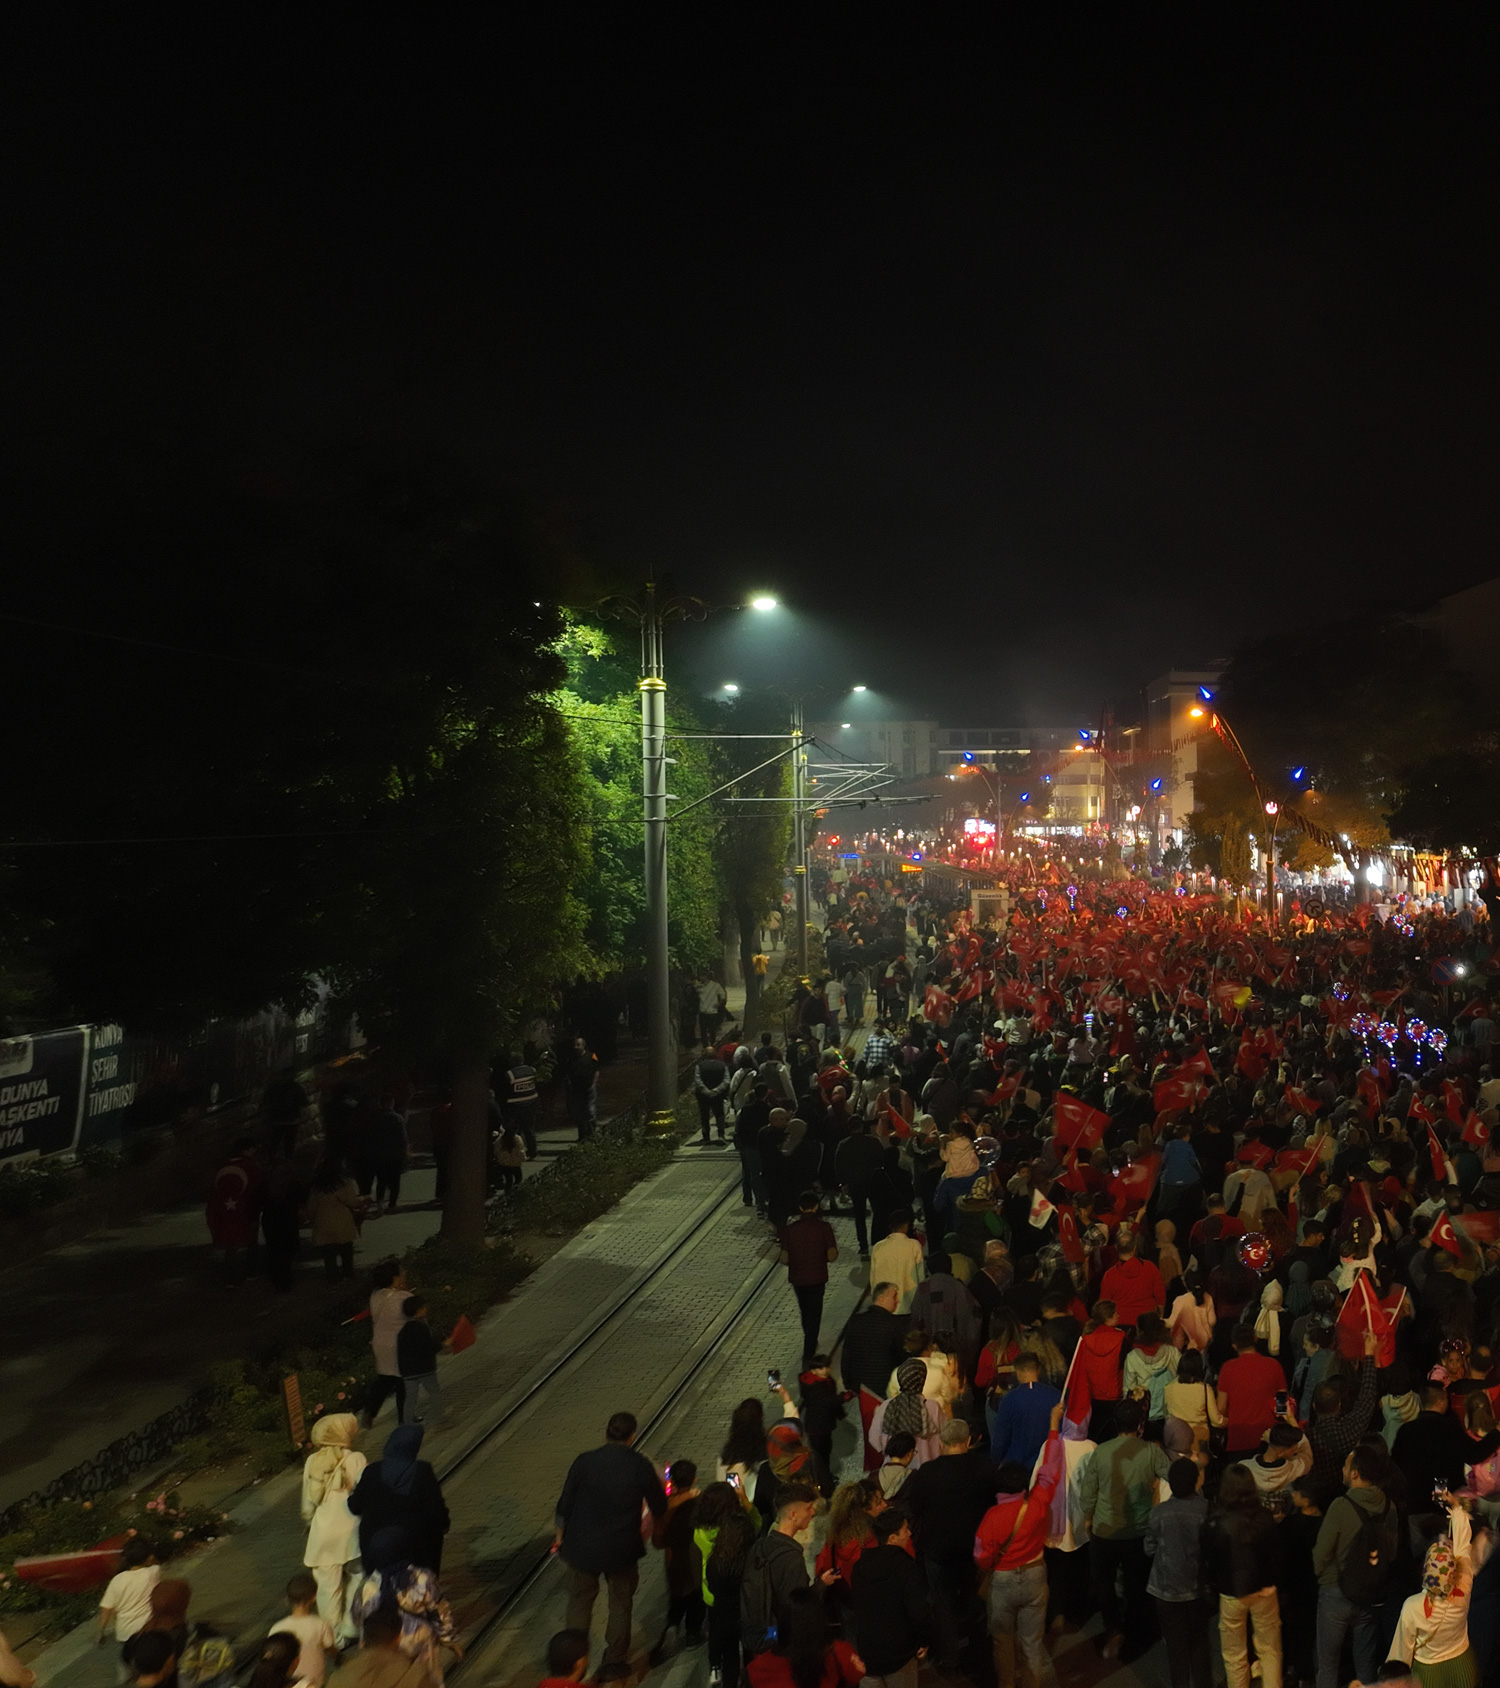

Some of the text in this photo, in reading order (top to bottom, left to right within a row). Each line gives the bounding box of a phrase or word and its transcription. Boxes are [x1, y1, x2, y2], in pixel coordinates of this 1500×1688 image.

[91, 1050, 118, 1088] ŞEHİR
[0, 1095, 61, 1127] AŞKENTİ
[88, 1081, 137, 1117] TİYATROSU
